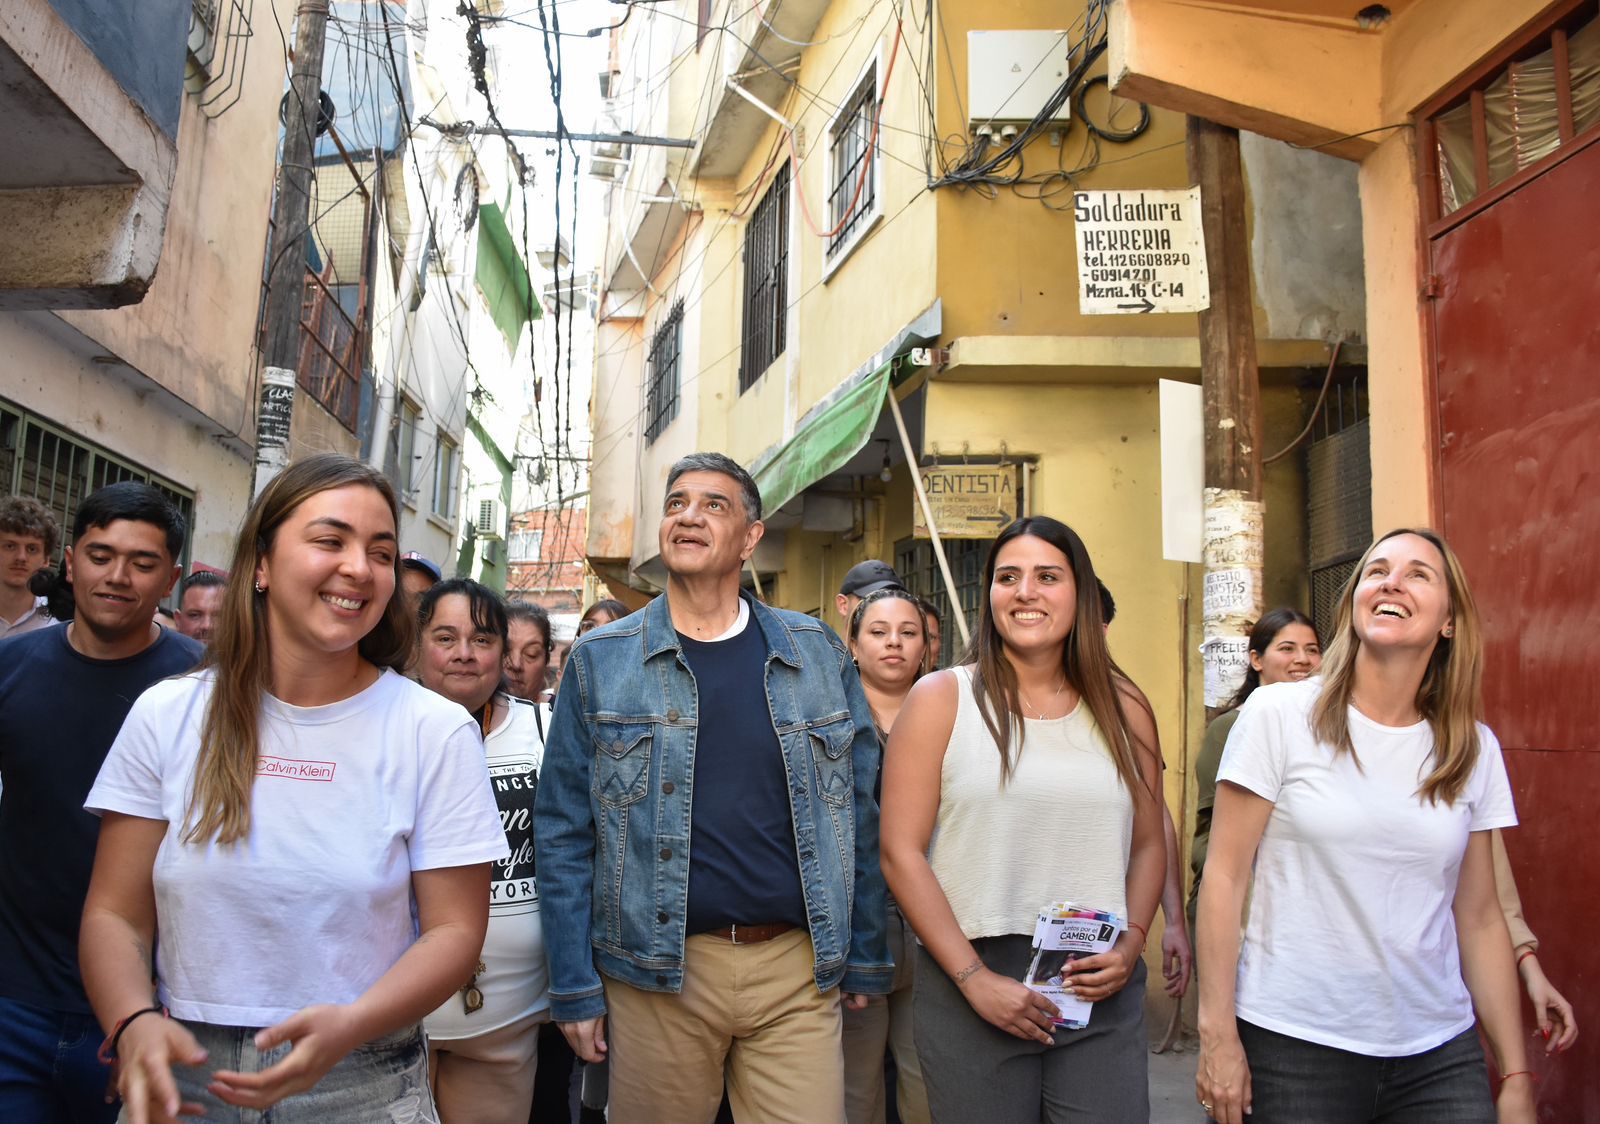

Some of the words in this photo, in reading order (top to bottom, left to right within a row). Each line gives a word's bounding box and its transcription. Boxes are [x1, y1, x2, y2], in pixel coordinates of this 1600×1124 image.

[1075, 193, 1182, 222] Soldadura
[1084, 228, 1171, 251] HERRERIA
[1152, 283, 1184, 298] C-14
[256, 760, 297, 775] Calvin
[300, 764, 330, 777] Klein
[496, 775, 534, 791] NCE
[1060, 932, 1096, 941] CAMBIO
[1103, 925, 1112, 938] 7
